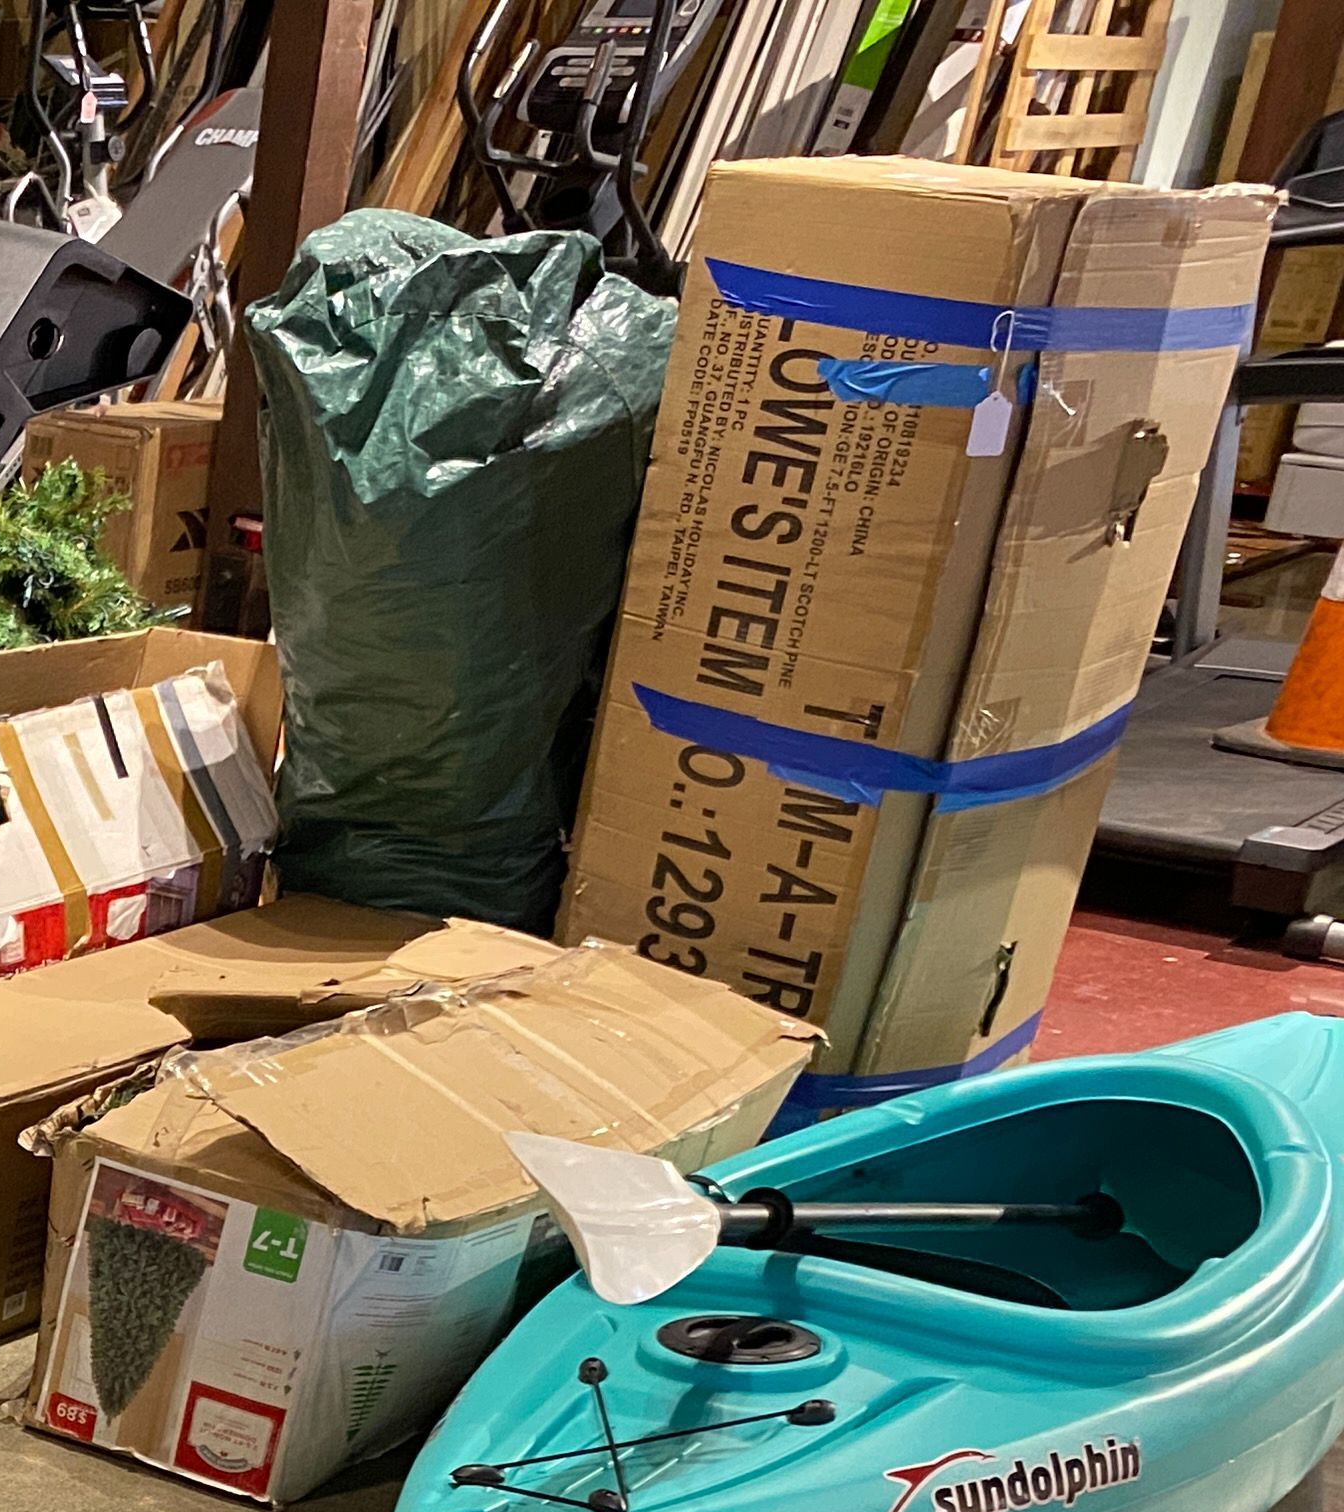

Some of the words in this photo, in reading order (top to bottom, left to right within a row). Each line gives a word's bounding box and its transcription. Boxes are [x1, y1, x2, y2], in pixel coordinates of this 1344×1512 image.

[702, 298, 723, 341] DATE
[714, 331, 731, 361] NO.
[689, 344, 712, 396] CODE:
[740, 313, 771, 394] UANTITY:
[676, 399, 699, 455] FP0519
[688, 390, 718, 470] GUANGFU
[711, 416, 727, 442] BY:
[731, 409, 747, 431] PC
[880, 409, 896, 433] OF
[694, 446, 720, 515] NICOLAS
[818, 466, 843, 516] 7.5-FT
[863, 435, 890, 502] ORIGIN:
[677, 518, 704, 587] HOLIDAY
[802, 519, 829, 580] 1200-LT
[849, 504, 874, 558] CHINA
[650, 582, 674, 641] TAIWAN
[669, 590, 687, 621] INC.
[696, 554, 792, 697] ITEM
[786, 581, 814, 648] SCOTCH
[777, 651, 797, 689] PINE
[252, 1231, 300, 1260] T-7
